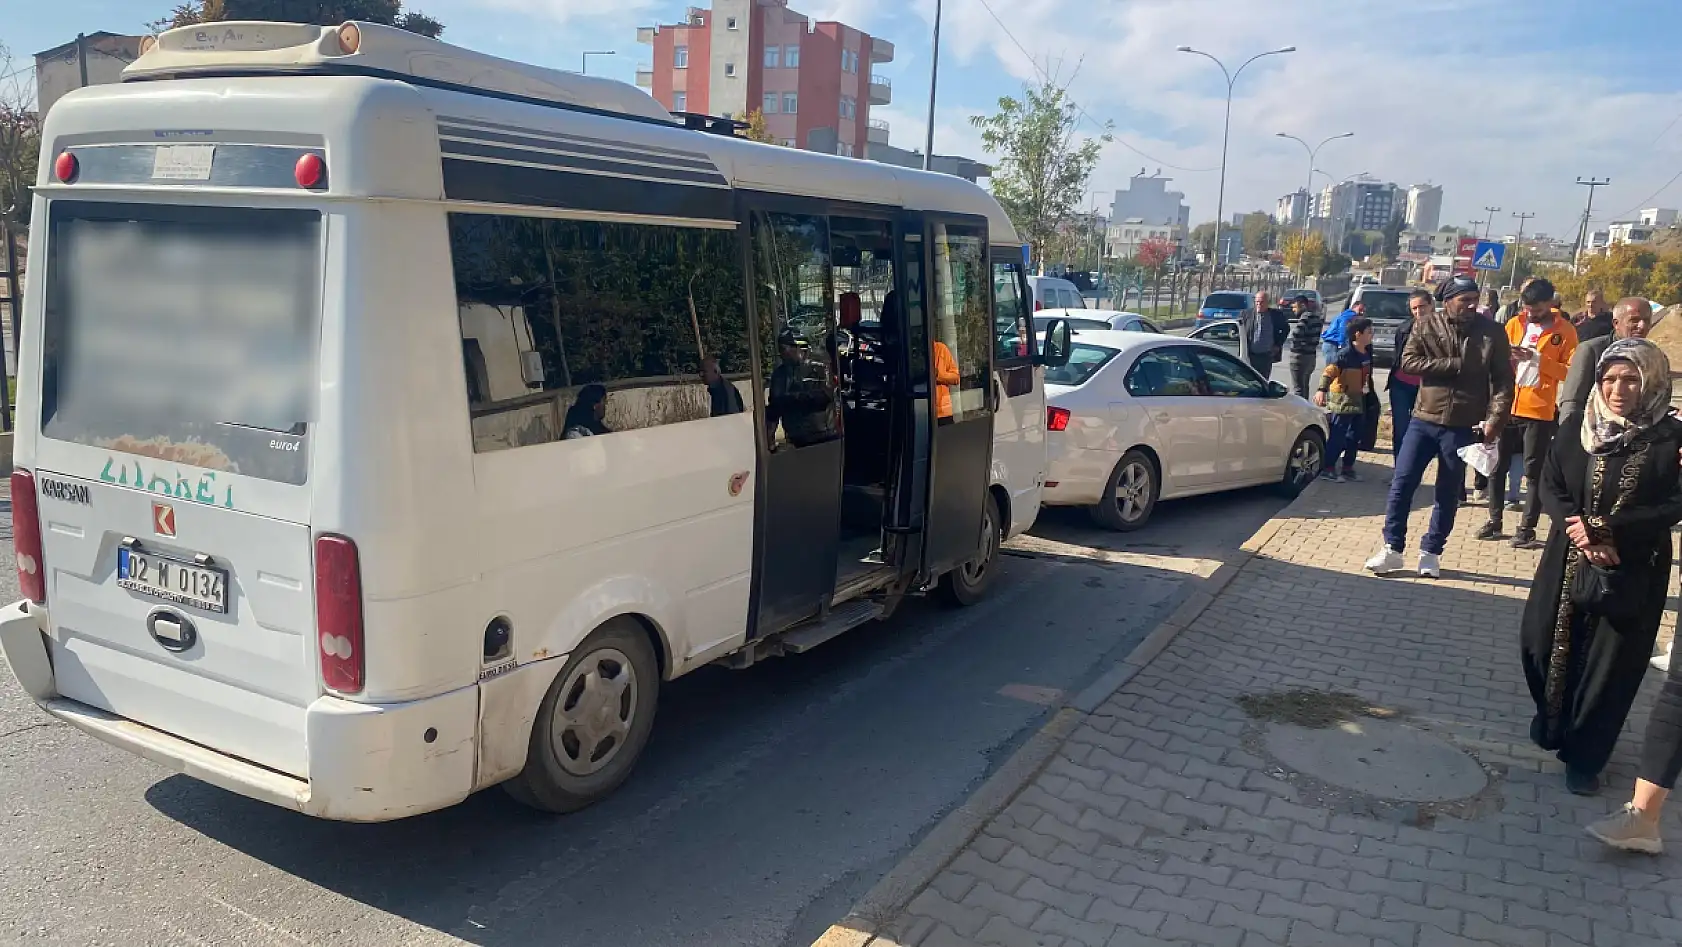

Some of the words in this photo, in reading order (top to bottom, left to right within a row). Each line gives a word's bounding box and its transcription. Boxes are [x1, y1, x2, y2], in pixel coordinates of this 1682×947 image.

[270, 439, 300, 452] euro4
[42, 477, 90, 504] KARSAN
[129, 555, 148, 581] 02
[158, 562, 170, 587] M
[179, 568, 221, 602] 0134
